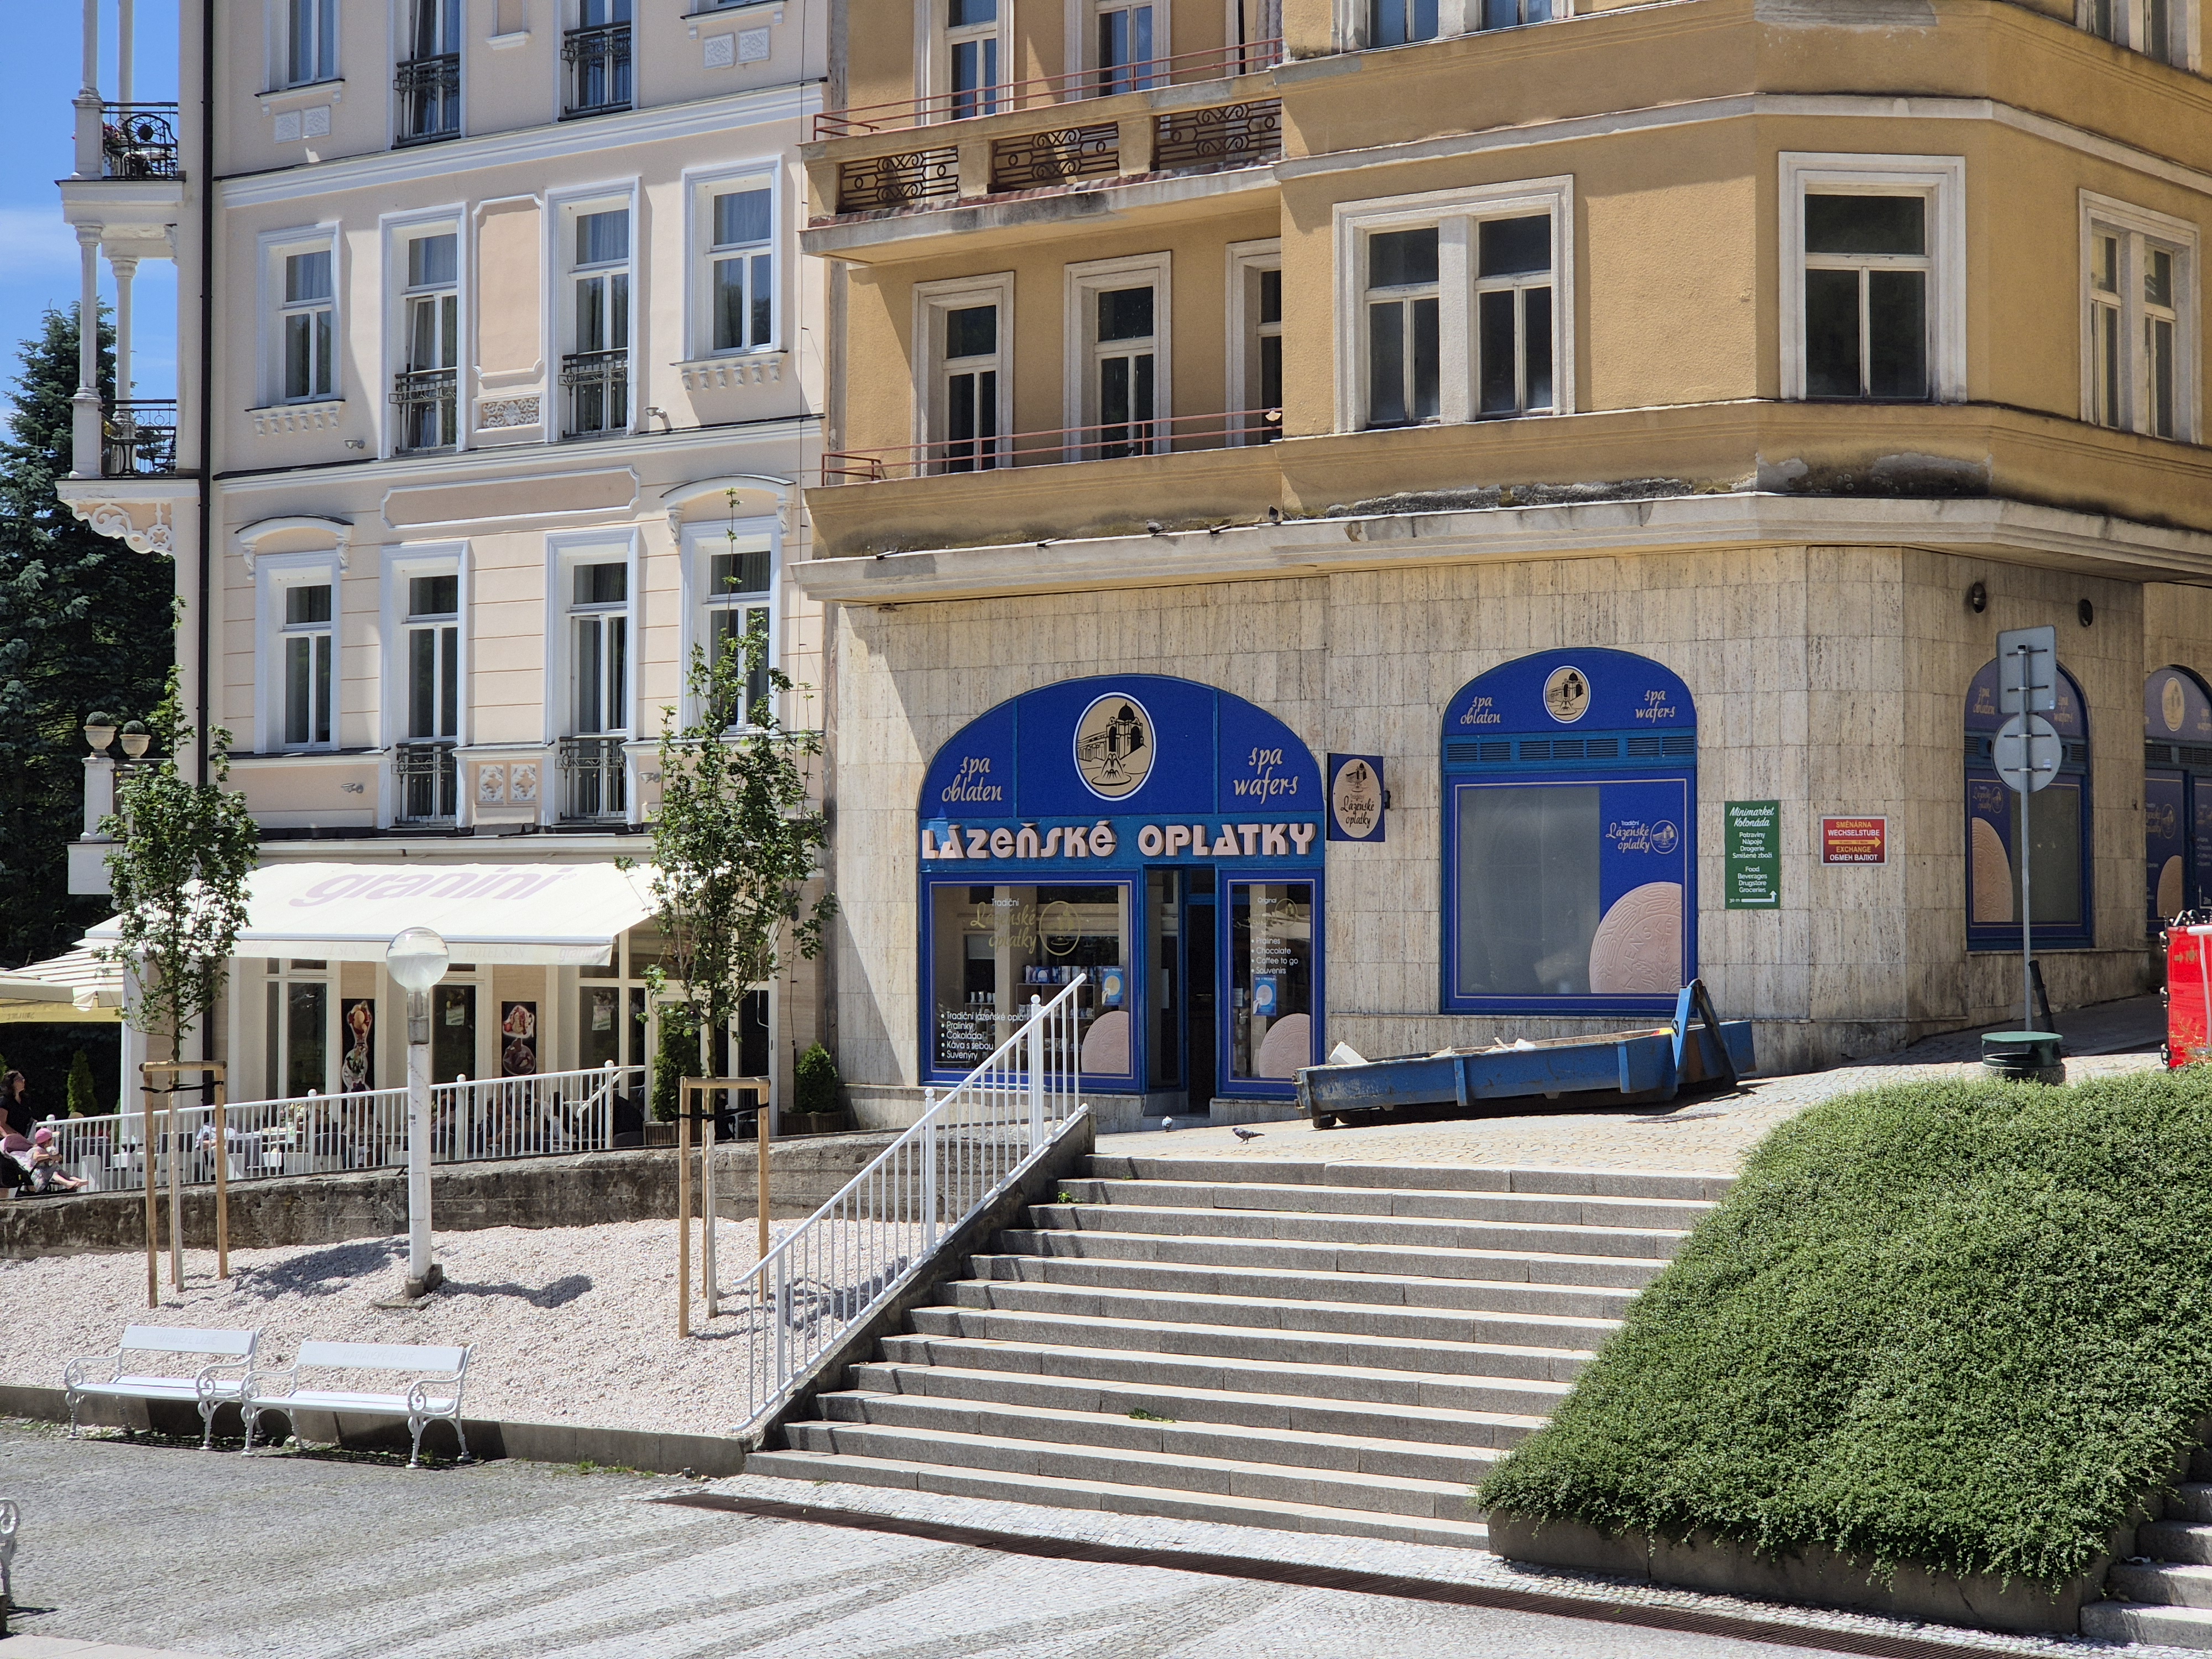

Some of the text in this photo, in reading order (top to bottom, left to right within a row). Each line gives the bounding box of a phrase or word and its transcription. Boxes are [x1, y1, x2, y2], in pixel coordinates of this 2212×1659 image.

[1472, 696, 1493, 712] spa
[1644, 690, 1666, 706] spa
[1460, 707, 1500, 724] oblaten
[1635, 701, 1676, 723] wafers
[1249, 747, 1282, 775] spa
[960, 757, 990, 782] spa
[942, 774, 1002, 802] oblaten
[1233, 766, 1298, 805] wafers
[1729, 805, 1774, 816] Minimarket
[1345, 811, 1371, 828] oplatky
[1734, 817, 1770, 827] Kolonáda
[1605, 822, 1649, 841] Lázeňské
[1138, 823, 1316, 857] OPLATKY
[1618, 836, 1650, 853] oplatky
[992, 898, 1019, 906] Tradiční
[302, 945, 359, 956] HOTEL SUN
[465, 946, 525, 958] HOTEL SUN
[946, 1011, 974, 1020] Tradiční
[975, 1012, 1005, 1021] lázeňské
[946, 1021, 973, 1032] Pralinky
[946, 1029, 982, 1040] Čokoláda
[946, 1040, 964, 1049] Káva
[946, 1050, 978, 1060] Suvenýry
